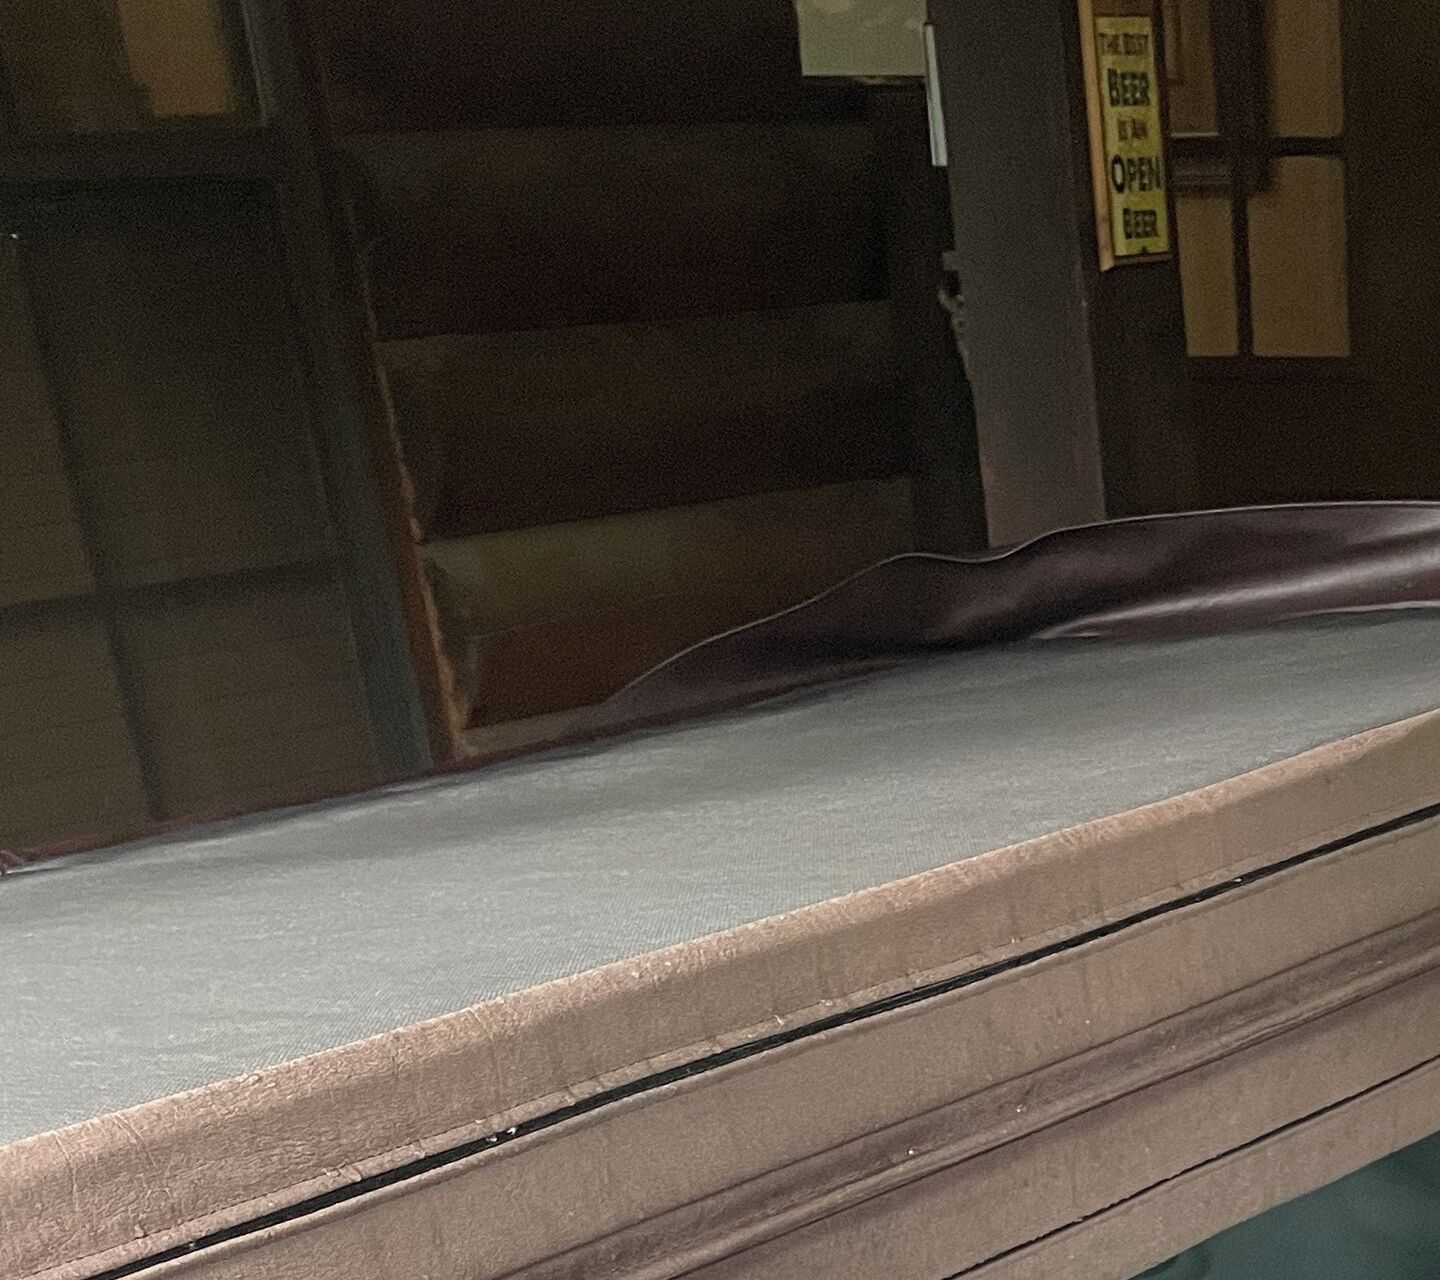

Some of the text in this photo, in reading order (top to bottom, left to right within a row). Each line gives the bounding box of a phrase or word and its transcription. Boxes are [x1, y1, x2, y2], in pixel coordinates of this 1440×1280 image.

[1107, 68, 1150, 107] BEER
[1111, 155, 1161, 193] OPEN
[1123, 208, 1159, 240] BEER
